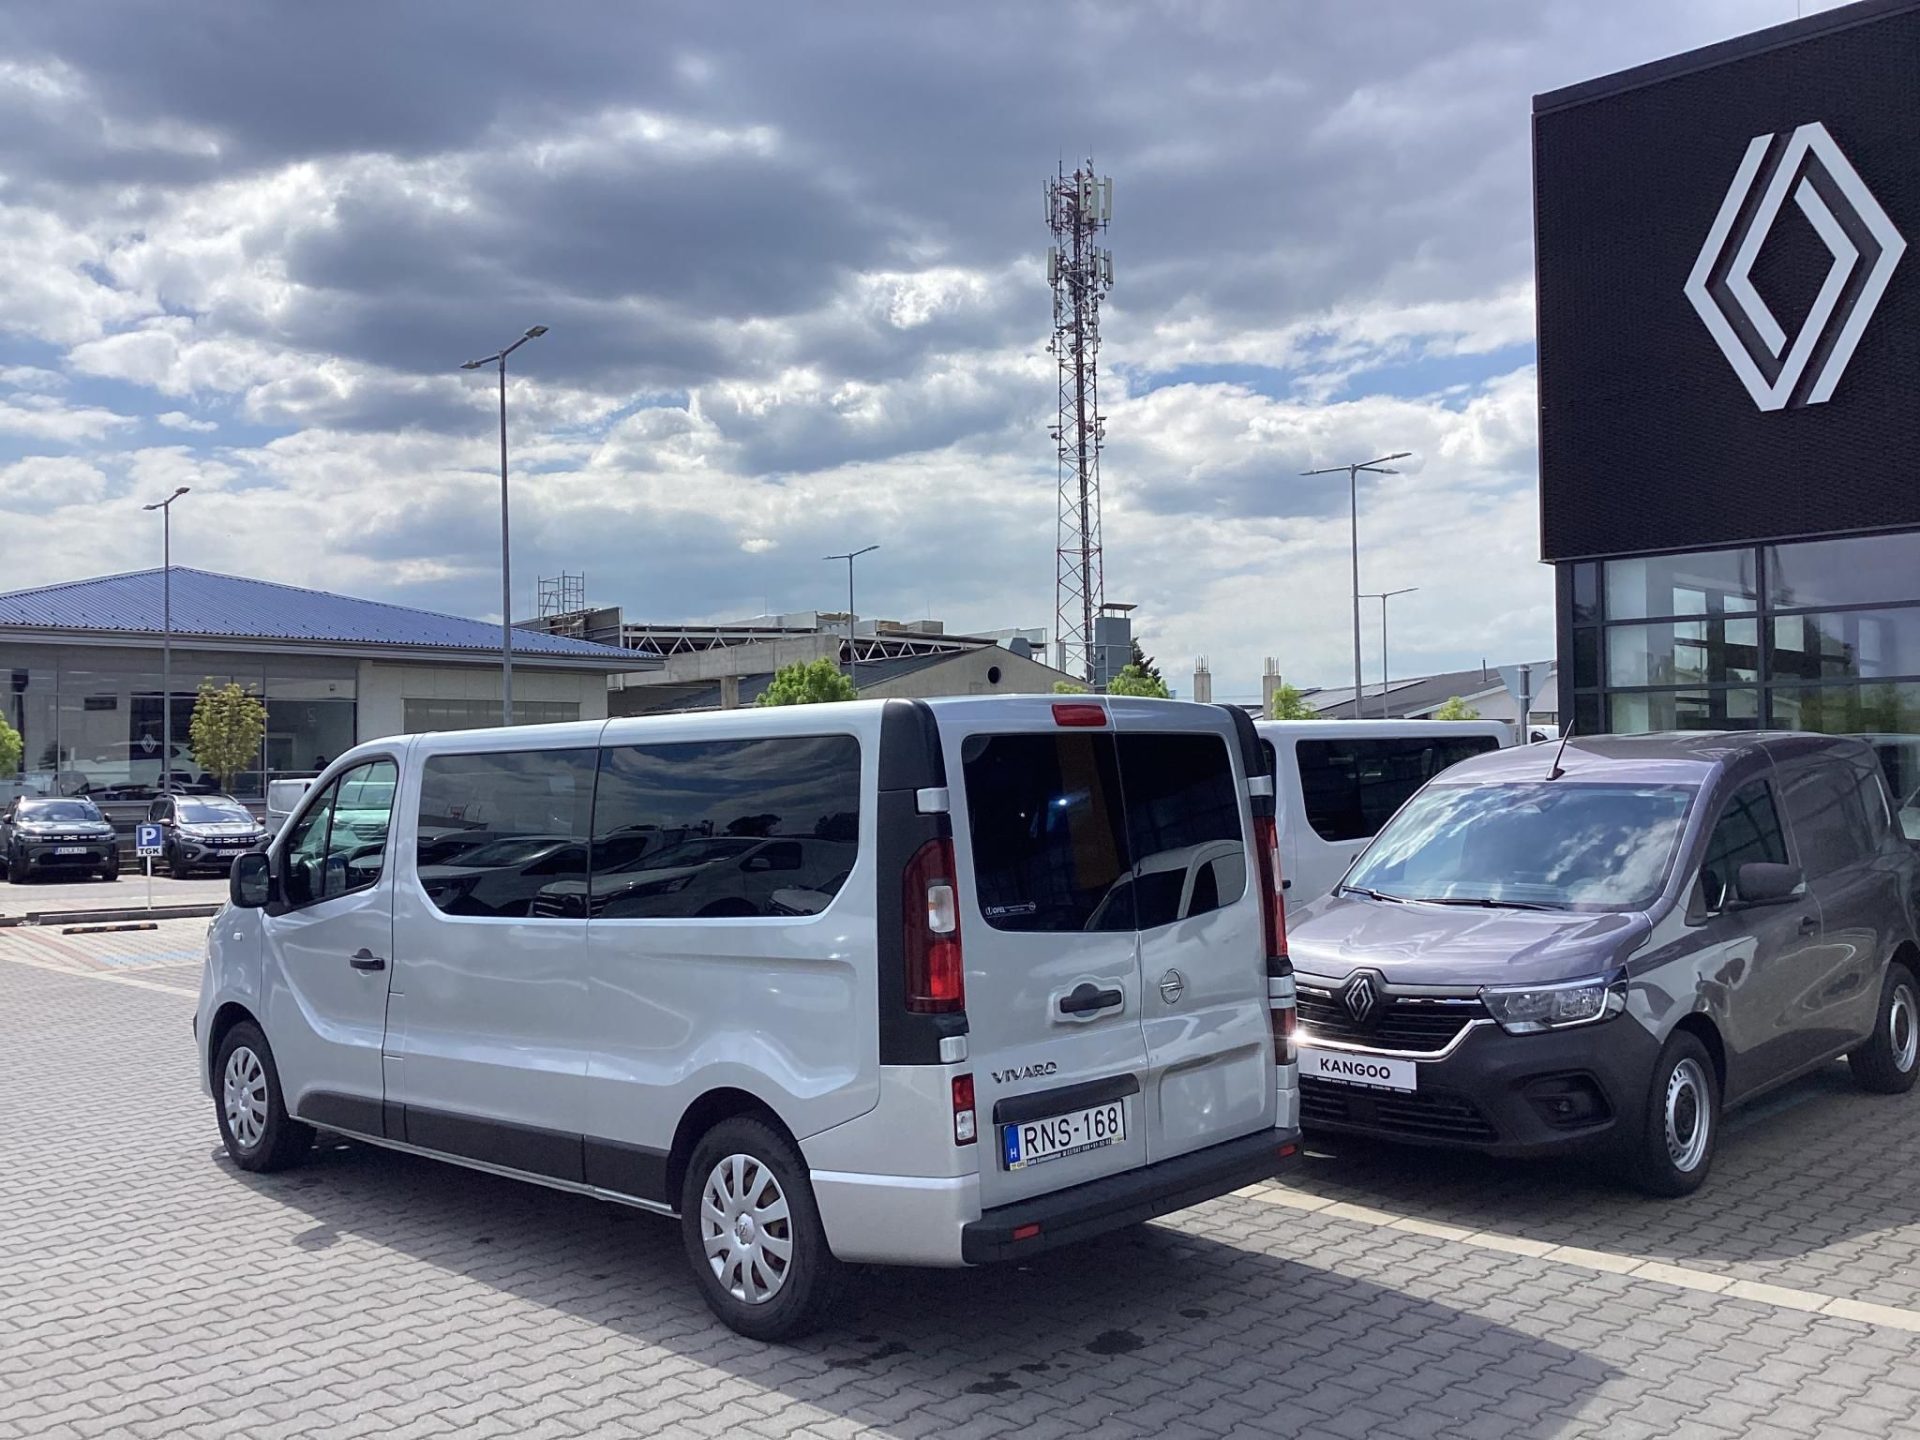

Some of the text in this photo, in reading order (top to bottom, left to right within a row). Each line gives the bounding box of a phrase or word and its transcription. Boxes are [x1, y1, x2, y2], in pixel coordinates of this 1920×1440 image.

[142, 828, 157, 845] P
[139, 847, 160, 855] TGK
[991, 1061, 1058, 1084] VIVARO
[1320, 1058, 1391, 1079] KANGOO
[1010, 1147, 1018, 1159] H
[1024, 1106, 1119, 1157] RNS-168
